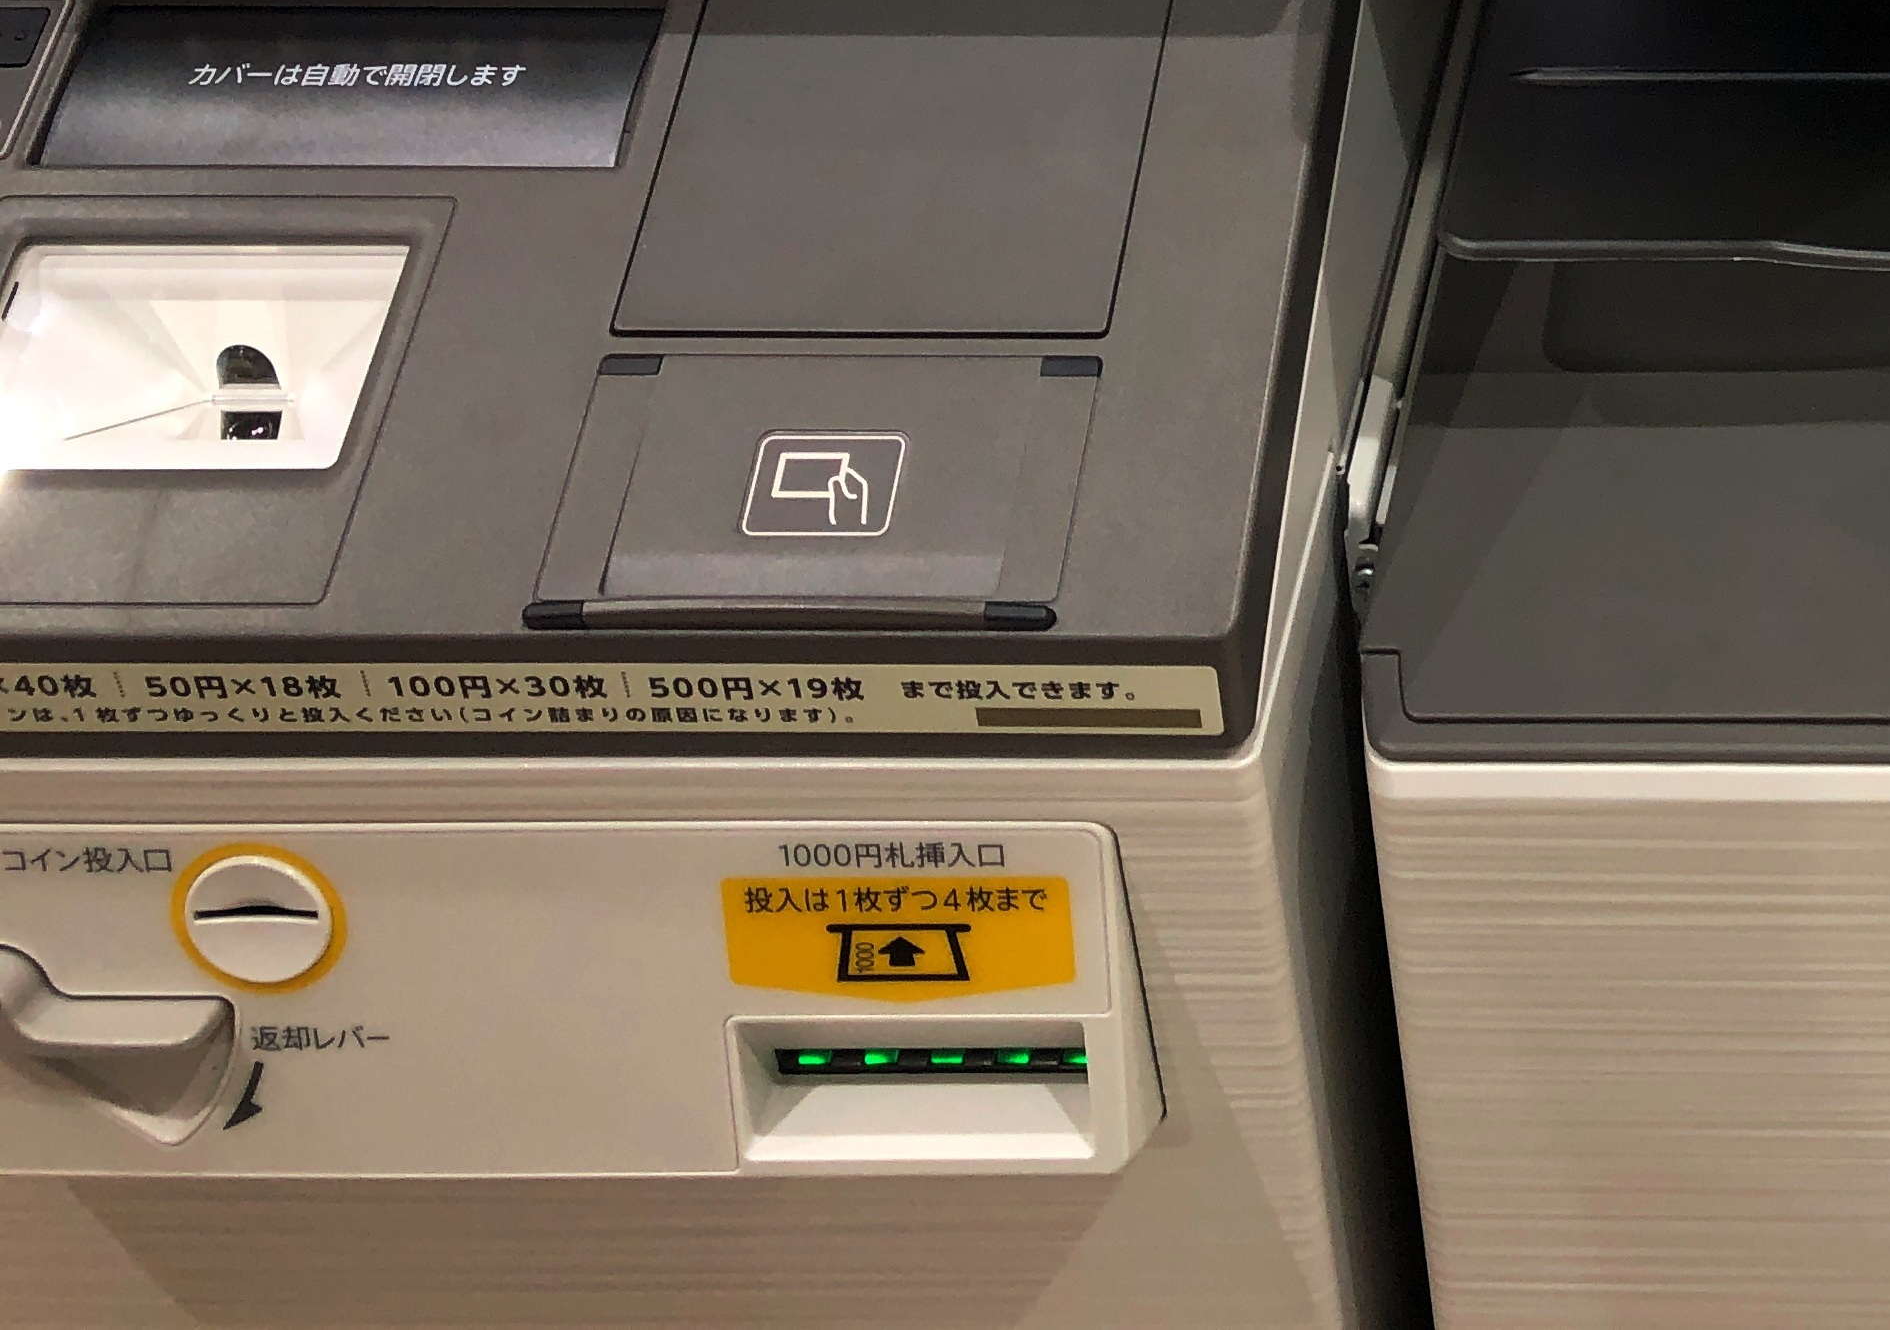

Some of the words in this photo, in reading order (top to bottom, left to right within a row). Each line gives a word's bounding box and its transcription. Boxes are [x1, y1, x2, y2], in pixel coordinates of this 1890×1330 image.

[188, 62, 527, 88] カバーは自動で開閉します
[146, 675, 342, 700] 50円×18枚
[388, 675, 609, 701] 100円×30枚
[648, 676, 865, 702] 500円×19枚
[900, 677, 1138, 702] まで投入できます。
[2, 846, 174, 874] コイン投入口
[778, 841, 1006, 870] 1000円札挿入口
[744, 885, 1048, 914] 投入は1枚ずつ4枚まで
[855, 941, 875, 975] 1000
[251, 1026, 391, 1053] 返却レバー
